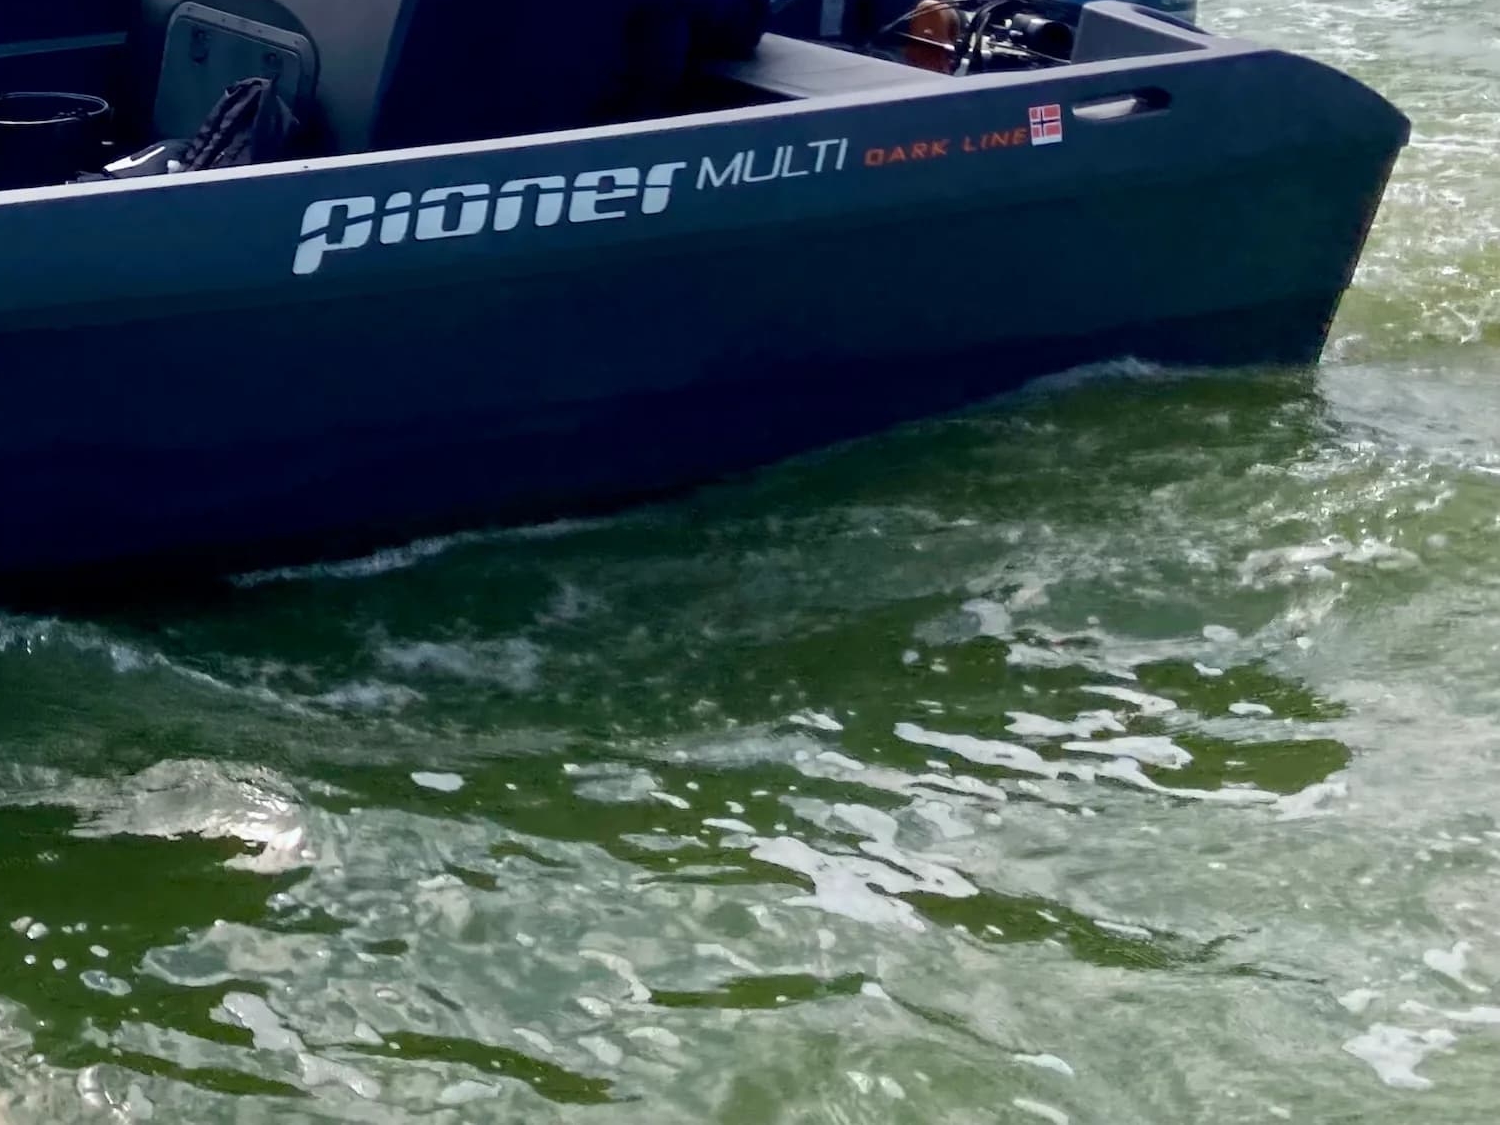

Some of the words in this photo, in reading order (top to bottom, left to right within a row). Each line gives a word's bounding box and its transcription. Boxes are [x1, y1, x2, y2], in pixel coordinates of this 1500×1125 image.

[292, 161, 687, 275] pioner
[695, 138, 848, 190] MULTI
[863, 139, 950, 167] DARK
[962, 127, 1029, 153] LINE
